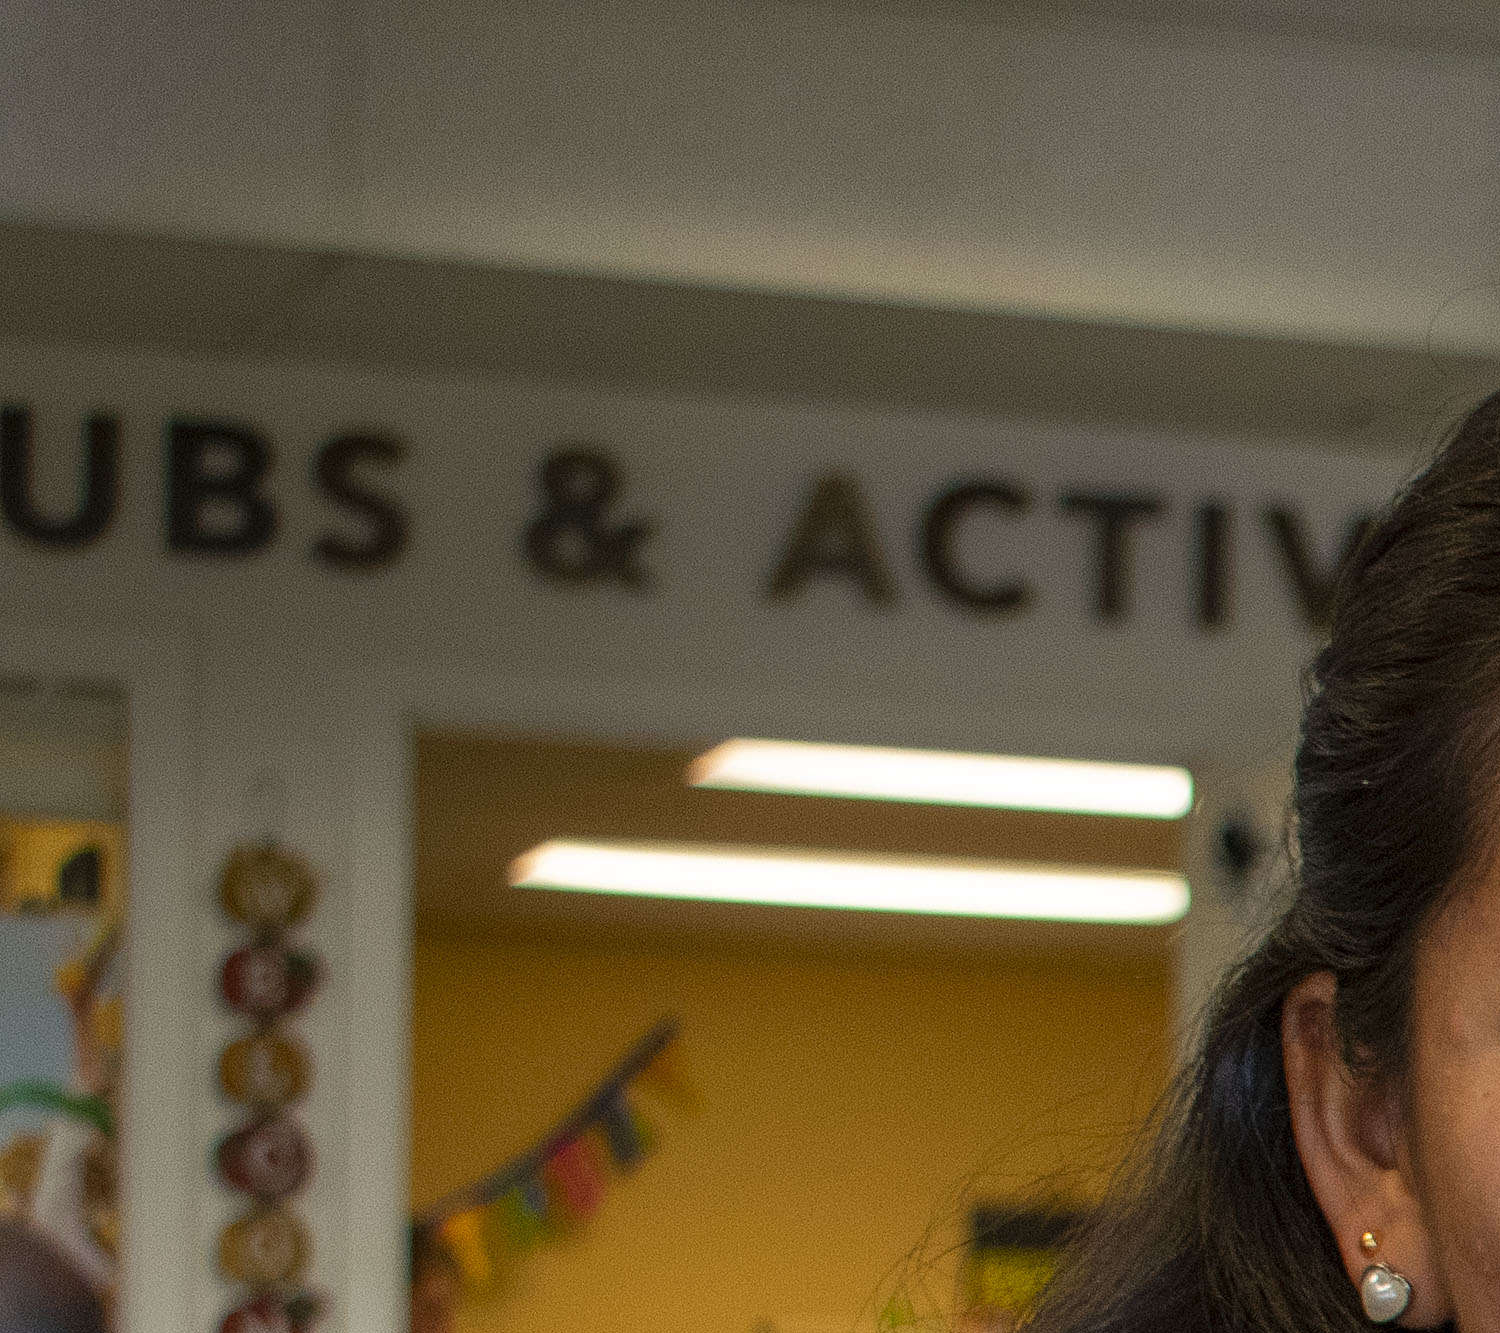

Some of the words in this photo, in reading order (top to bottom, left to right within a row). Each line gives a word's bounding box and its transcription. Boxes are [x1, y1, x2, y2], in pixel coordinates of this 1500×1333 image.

[0, 401, 415, 575] UBS
[521, 442, 655, 590] &
[766, 468, 1378, 634] ACTIV
